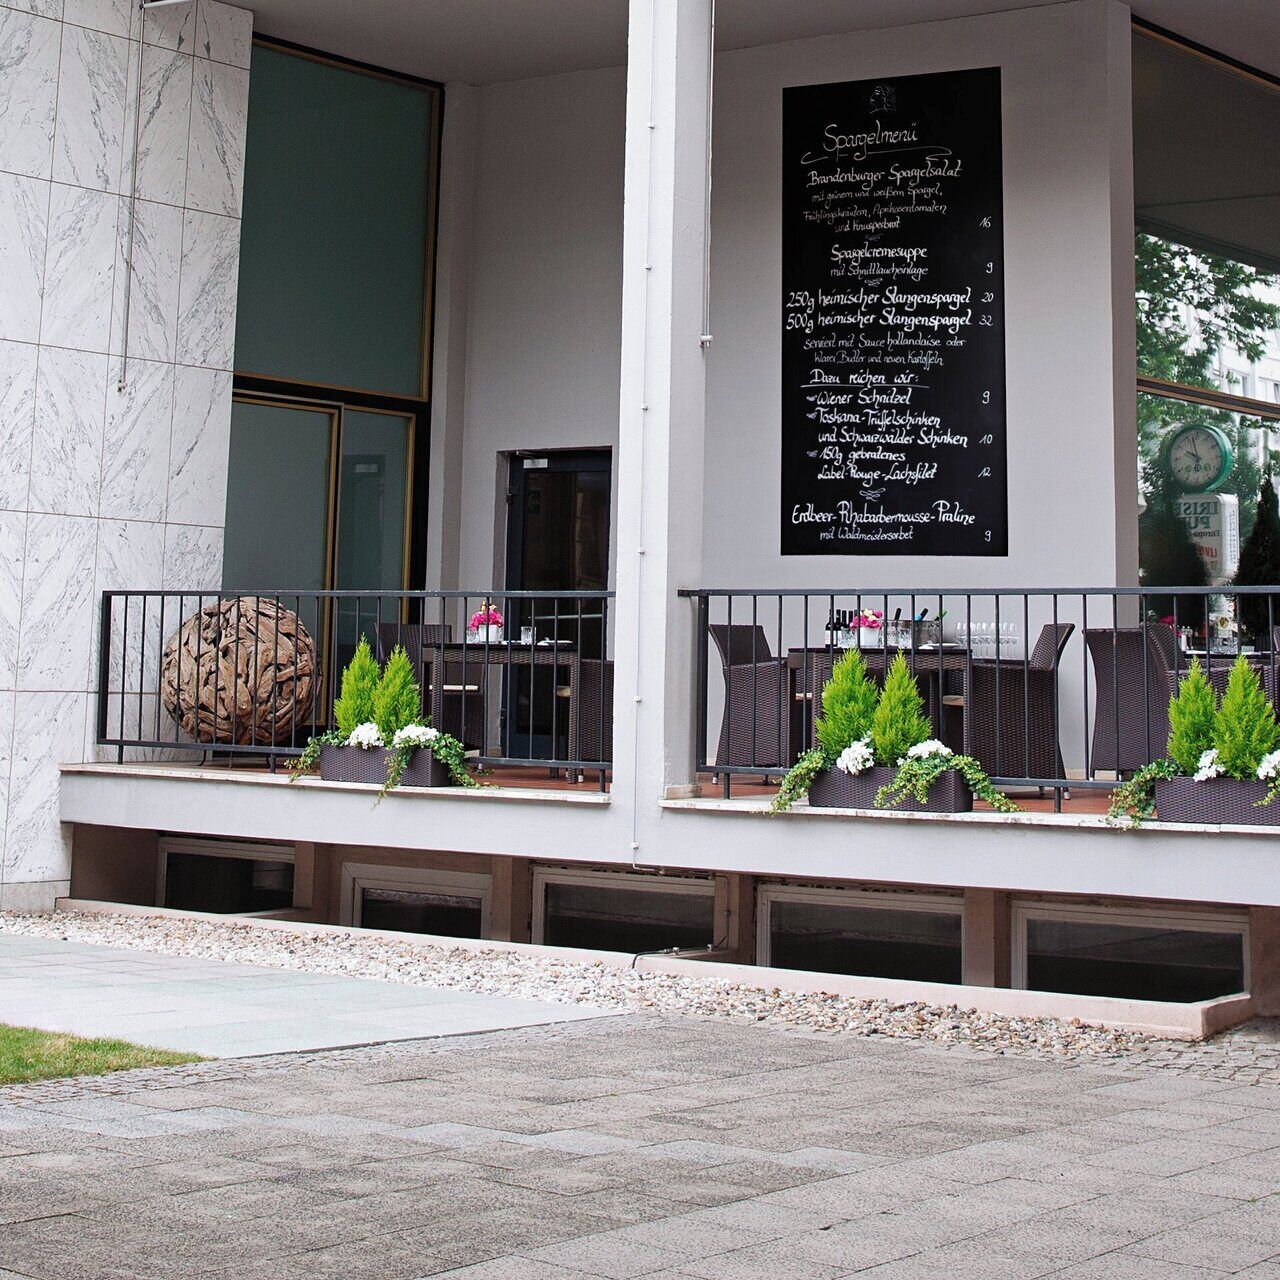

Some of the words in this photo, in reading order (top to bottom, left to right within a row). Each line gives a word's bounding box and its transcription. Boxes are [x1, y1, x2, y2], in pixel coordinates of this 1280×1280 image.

[822, 120, 918, 161] Spargelmenü
[806, 168, 886, 190] Brandenburger
[888, 159, 962, 185] Spargelsalat
[812, 192, 825, 202] mit
[855, 187, 870, 197] und
[834, 221, 850, 233] und
[979, 216, 992, 228] 16
[830, 242, 928, 265] Spargelcremesuppe
[830, 263, 845, 277] mit
[985, 261, 994, 273] 9
[786, 291, 815, 314] 250g
[818, 287, 880, 311] heimischer
[881, 286, 971, 311] Stangenspargel
[981, 292, 994, 303] 20
[786, 312, 814, 334] 500g
[817, 310, 877, 329] heimischer
[879, 307, 972, 334] Stangenspargel
[979, 315, 994, 326] 32
[803, 333, 837, 350] serviert
[838, 330, 855, 347] mit
[858, 332, 886, 348] Sauce
[886, 331, 942, 351] hollandaise
[945, 335, 967, 347] oder
[867, 351, 882, 364] und
[907, 350, 944, 370] Kartoffeln
[810, 368, 841, 384] Dazu
[848, 370, 886, 388] reichen
[894, 370, 919, 384] wir:
[816, 391, 853, 405] Wiener
[857, 387, 912, 409] Schnitzel
[982, 390, 991, 404] 9
[818, 426, 837, 443] und
[838, 426, 915, 447] Schwarzwälder
[917, 427, 969, 448] Schinken
[978, 434, 994, 445] 10
[819, 446, 843, 465] 150g
[847, 446, 906, 466] gebratenes
[977, 467, 992, 478] 12
[820, 526, 835, 541] mit
[837, 526, 914, 541] Waldmeistersorbet
[984, 530, 992, 542] 9
